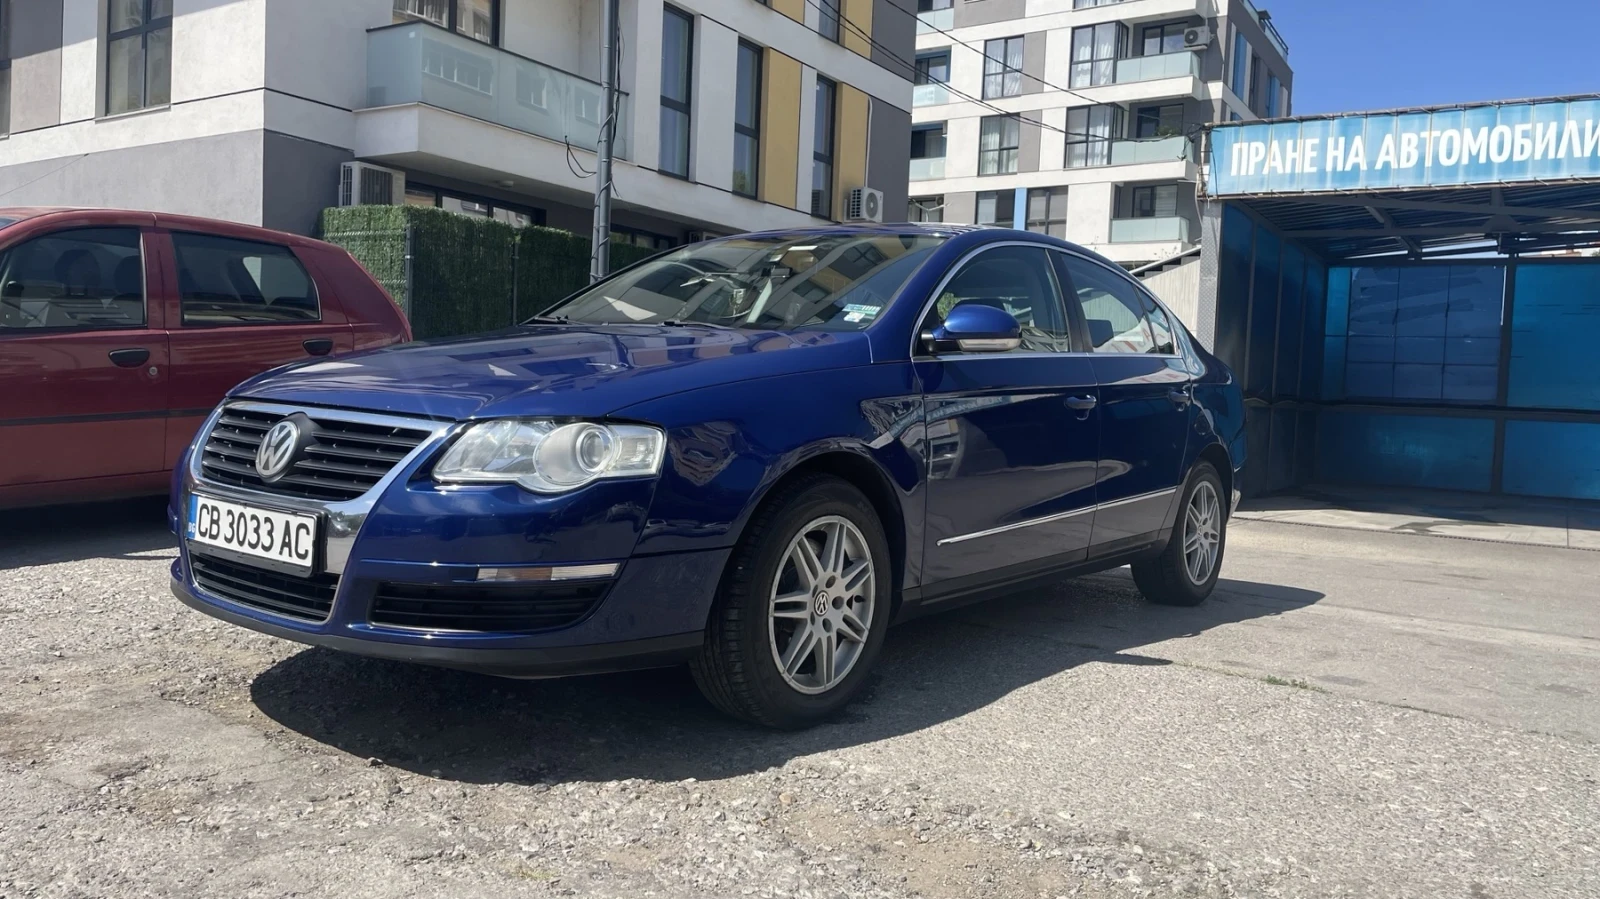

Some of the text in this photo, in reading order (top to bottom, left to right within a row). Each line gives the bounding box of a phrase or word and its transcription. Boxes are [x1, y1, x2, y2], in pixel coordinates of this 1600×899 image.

[1230, 119, 1600, 177] ПРАНЕ НА АВТОМОБИЛИ
[198, 503, 311, 560] CB 3033 AC
